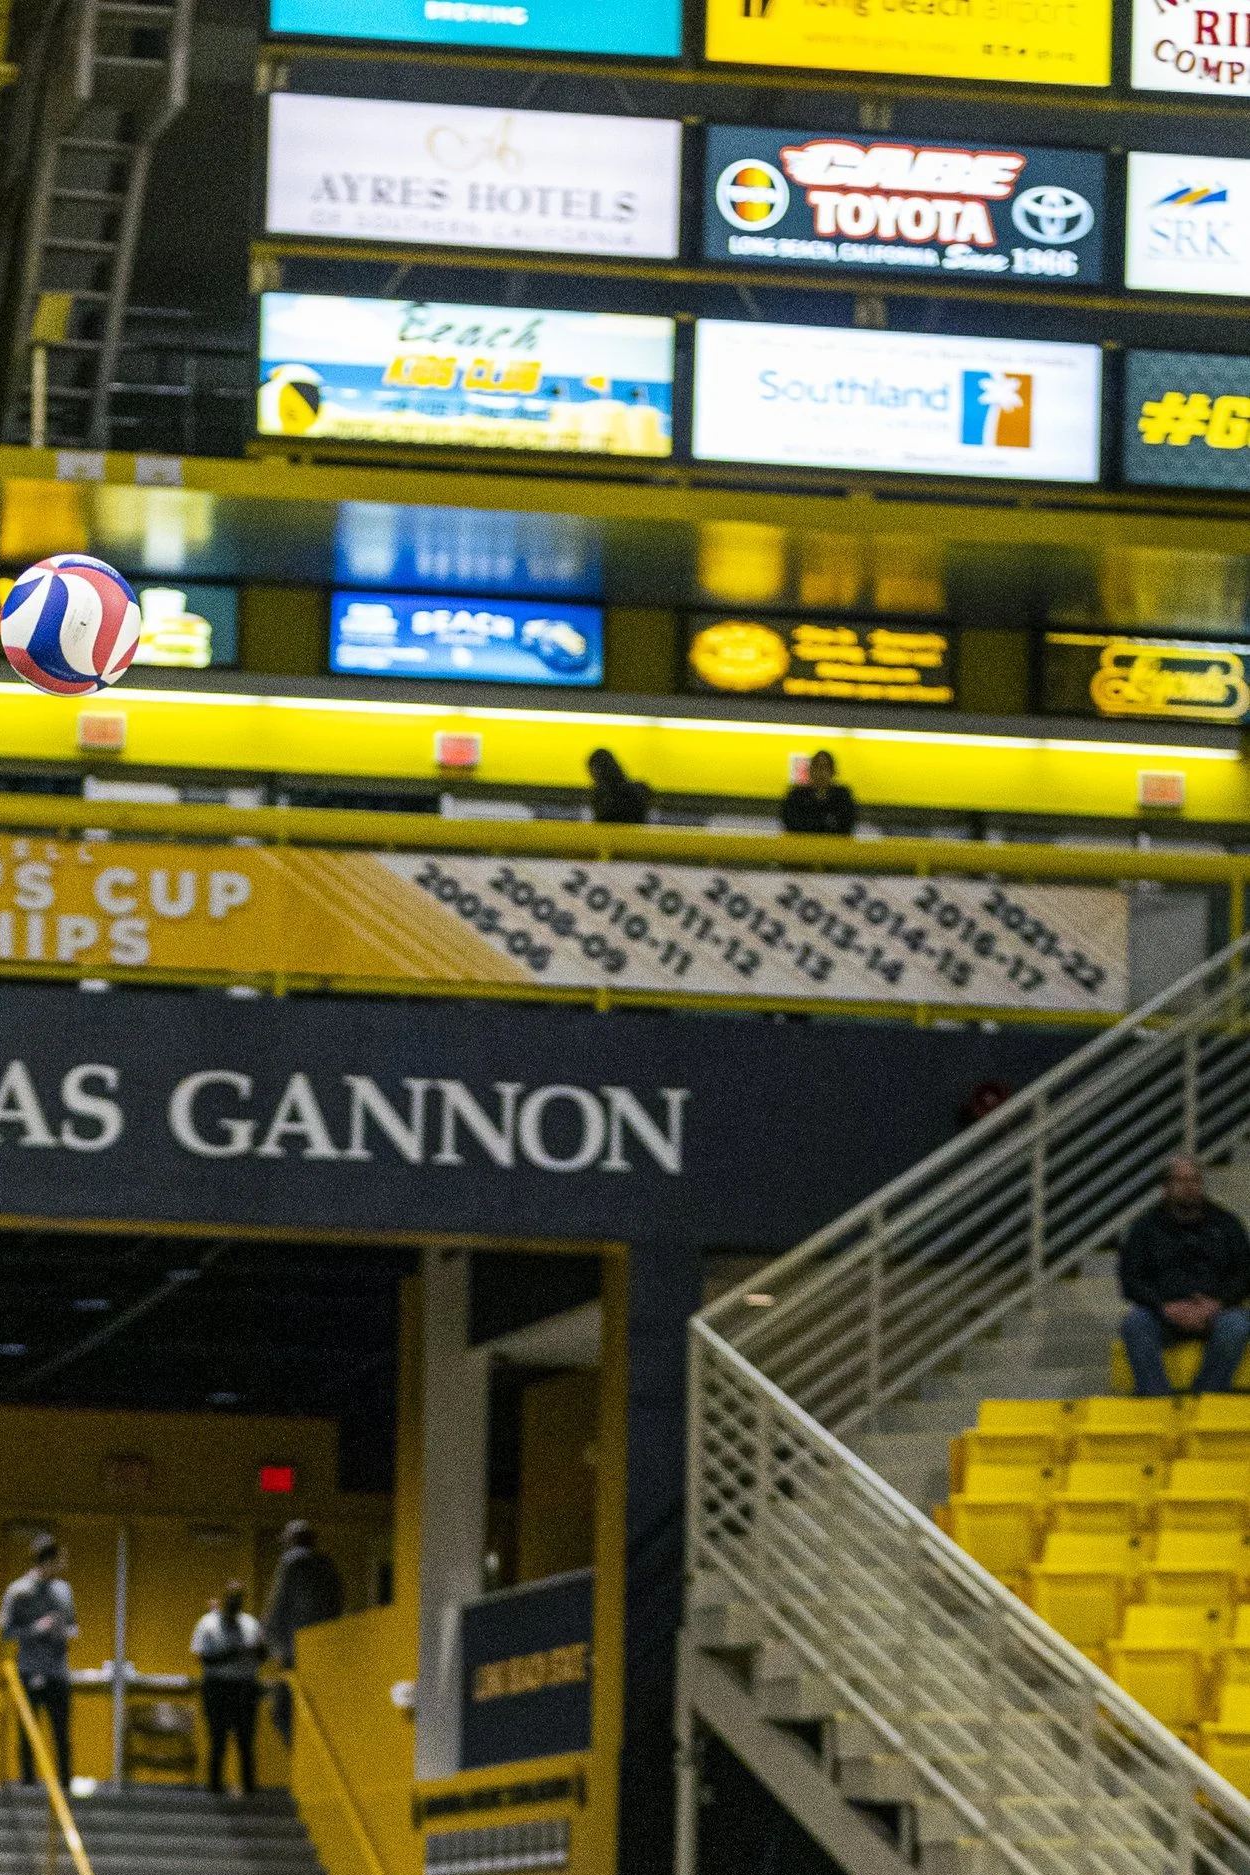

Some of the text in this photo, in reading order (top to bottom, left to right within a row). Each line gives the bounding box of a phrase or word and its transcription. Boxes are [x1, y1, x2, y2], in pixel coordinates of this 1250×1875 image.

[1195, 10, 1250, 47] RI
[1153, 38, 1250, 84] COMP
[779, 140, 1026, 199] CABE
[311, 172, 637, 224] AYRES HOTELS
[808, 190, 996, 247] TOYOTA
[1149, 215, 1232, 258] SRK
[398, 300, 546, 351] Beach
[759, 369, 949, 413] Southland
[1138, 392, 1250, 448] #G
[95, 867, 253, 921] CUP
[562, 869, 693, 976] 2010-11
[169, 1069, 689, 1175] GANNON
